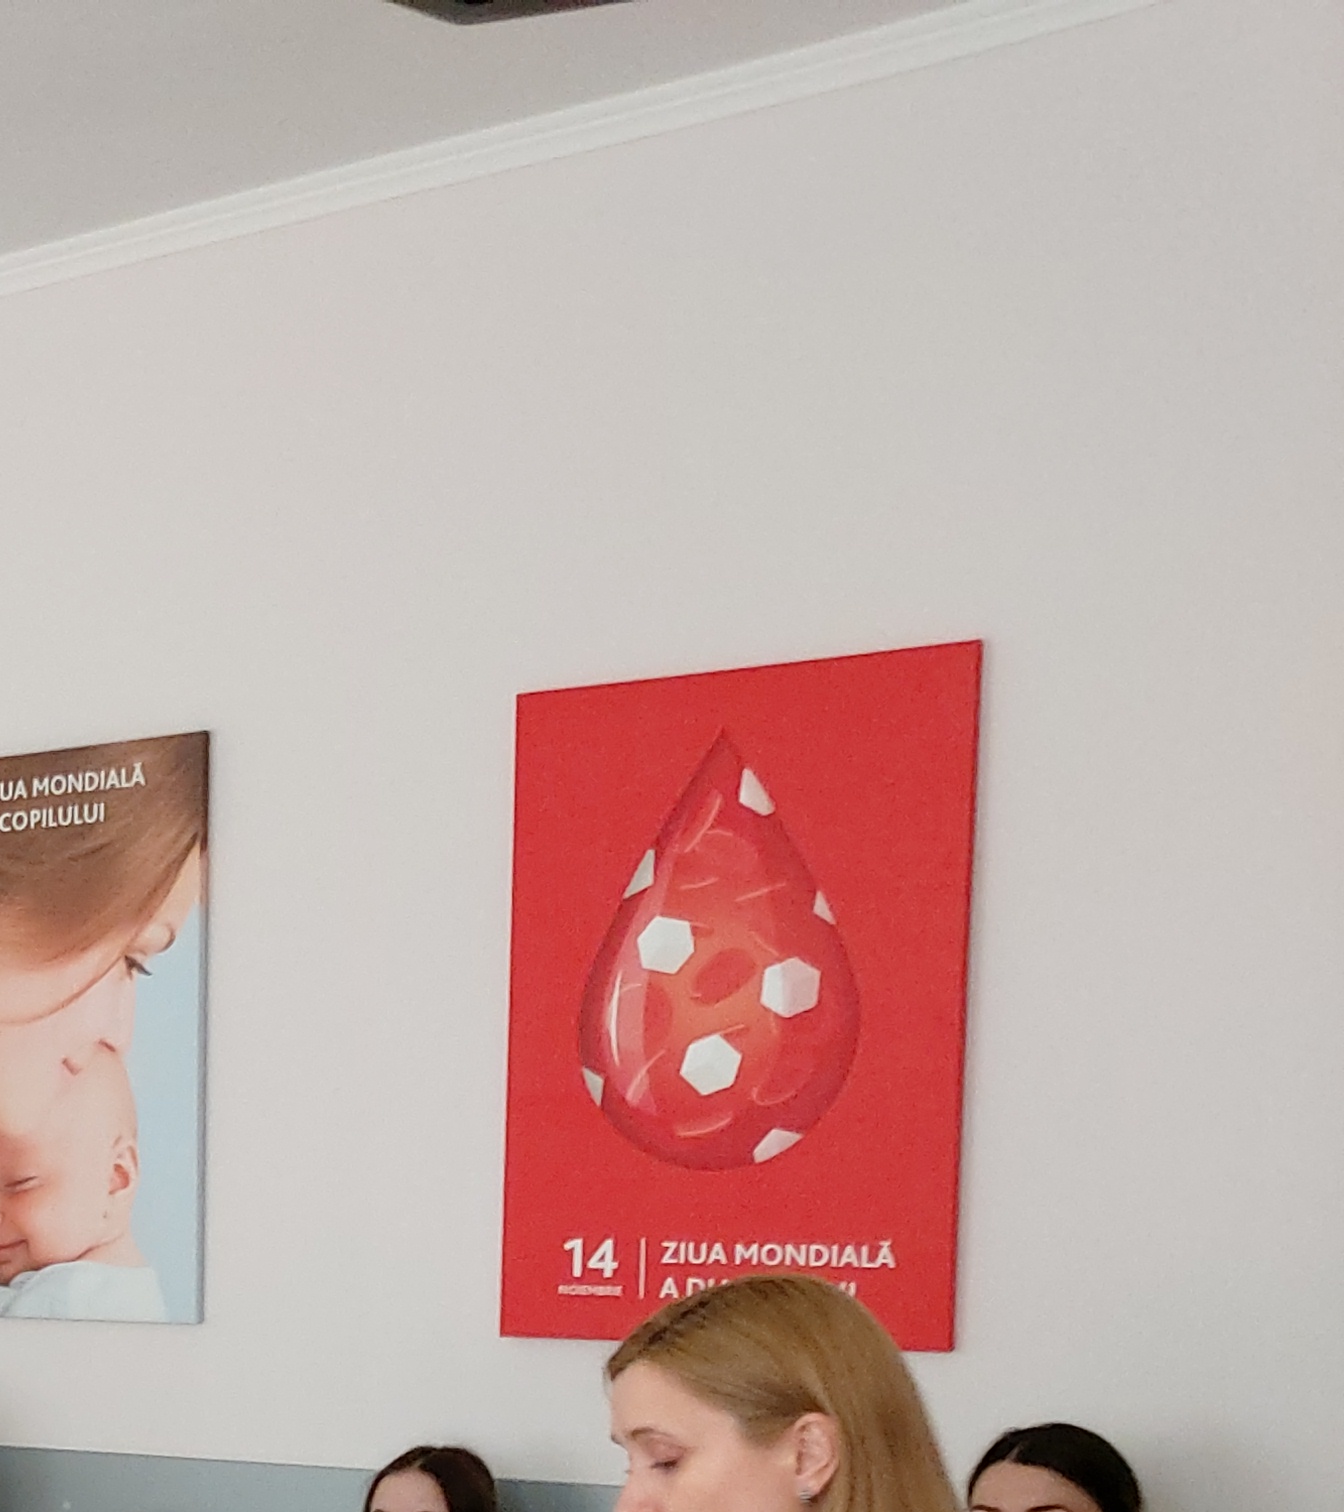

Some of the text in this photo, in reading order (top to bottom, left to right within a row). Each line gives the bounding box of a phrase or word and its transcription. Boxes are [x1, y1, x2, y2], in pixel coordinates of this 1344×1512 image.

[32, 762, 146, 797] MONDIALĂ
[563, 1237, 619, 1278] 14
[660, 1238, 896, 1269] ZIUA MONDIALĂ
[658, 1277, 679, 1298] A
